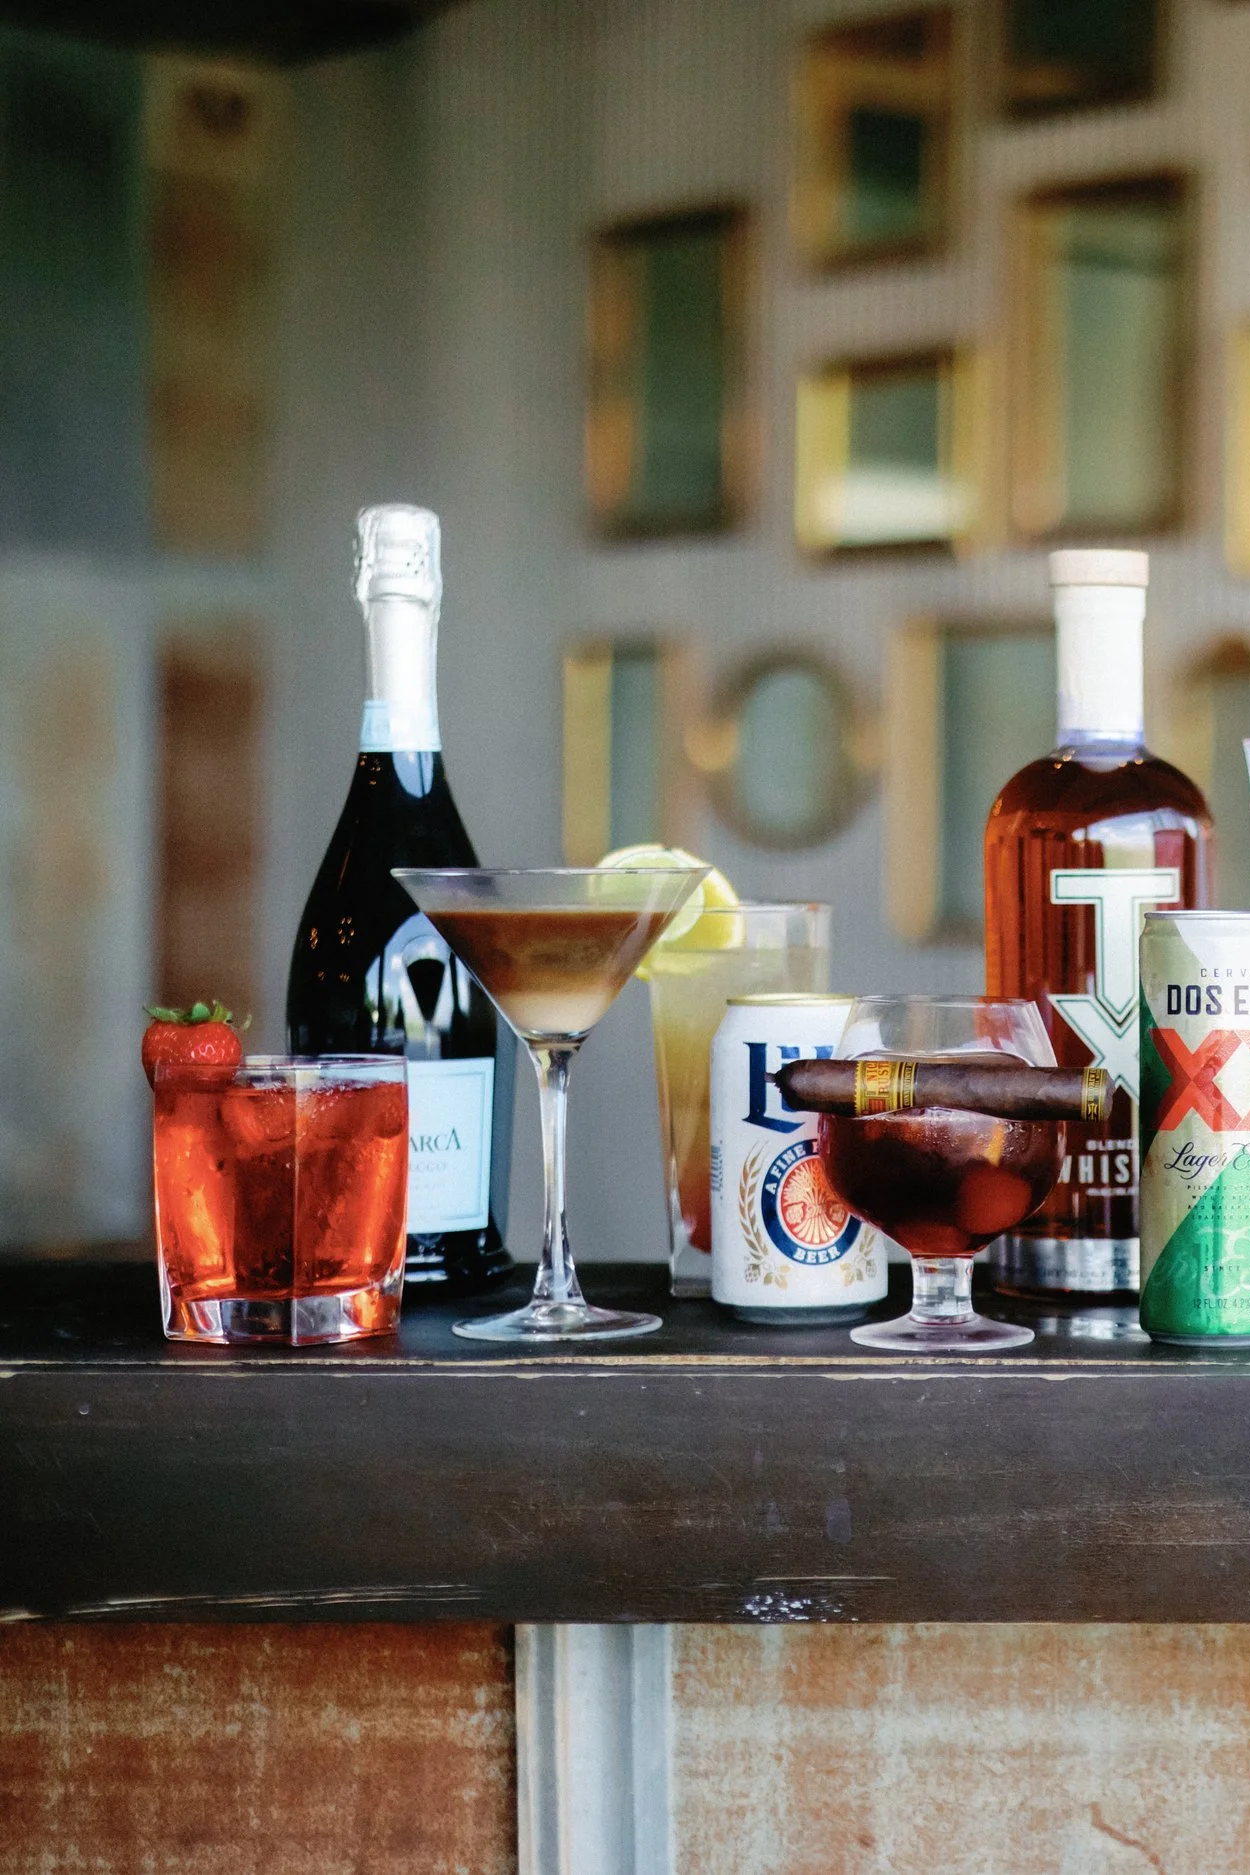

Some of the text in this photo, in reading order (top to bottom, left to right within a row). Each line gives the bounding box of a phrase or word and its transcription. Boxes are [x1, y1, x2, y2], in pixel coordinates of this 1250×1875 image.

[1167, 984, 1223, 1016] DOS
[765, 1144, 808, 1196] A FINE
[1164, 1141, 1229, 1181] Lager
[793, 1246, 842, 1264] BEER
